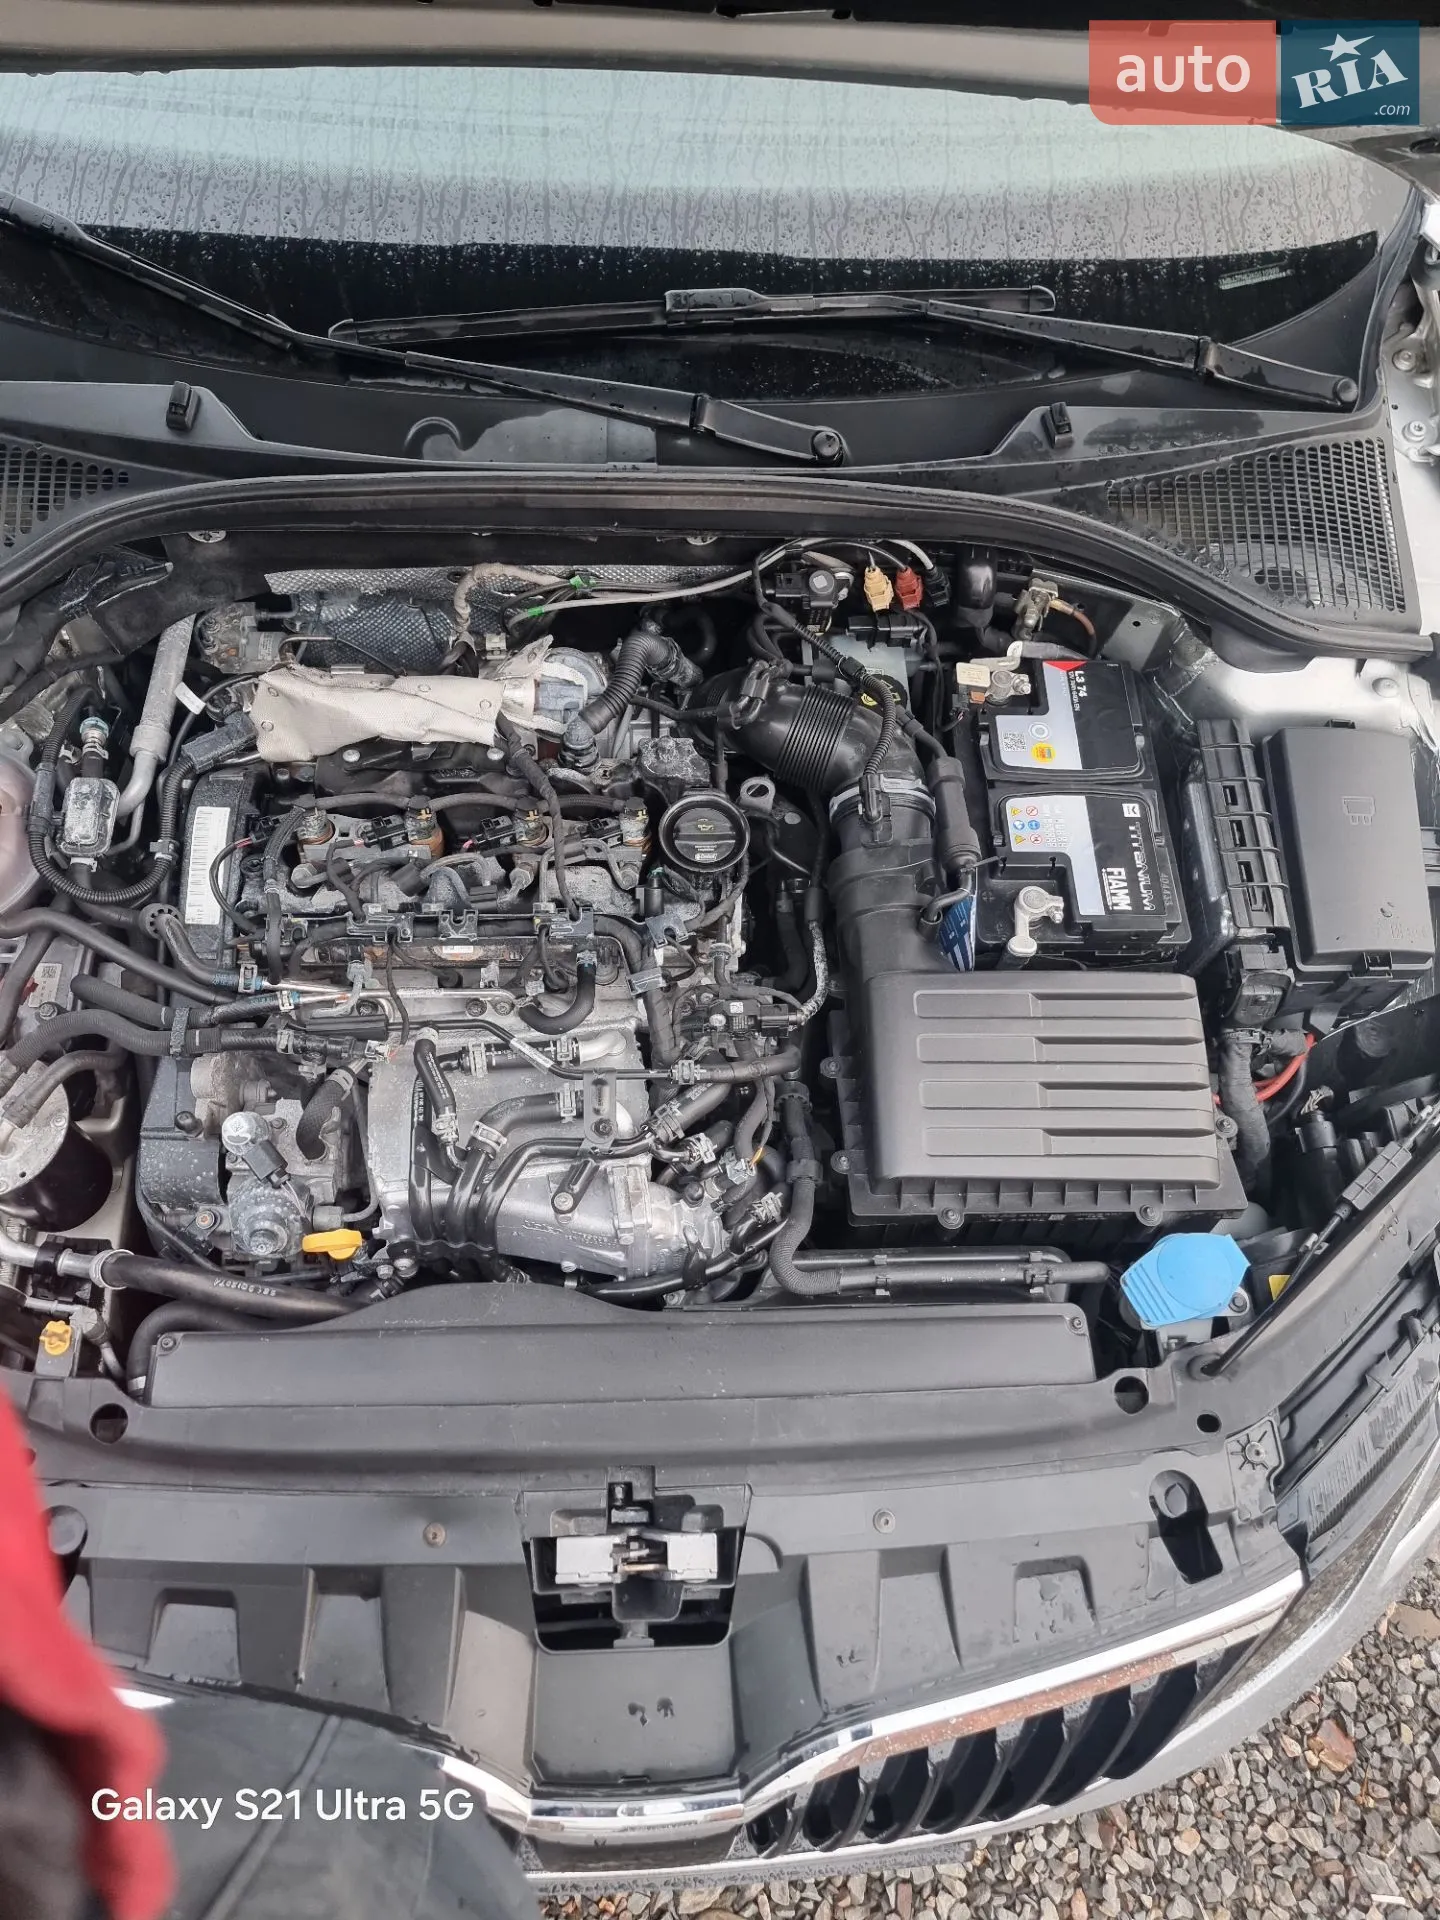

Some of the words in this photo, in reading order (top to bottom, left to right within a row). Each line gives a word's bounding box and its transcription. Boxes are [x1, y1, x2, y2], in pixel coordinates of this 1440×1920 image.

[1075, 670, 1085, 683] L3
[1077, 685, 1088, 697] 74
[1129, 822, 1155, 911] TITANIUM
[1107, 867, 1132, 911] FIAMM
